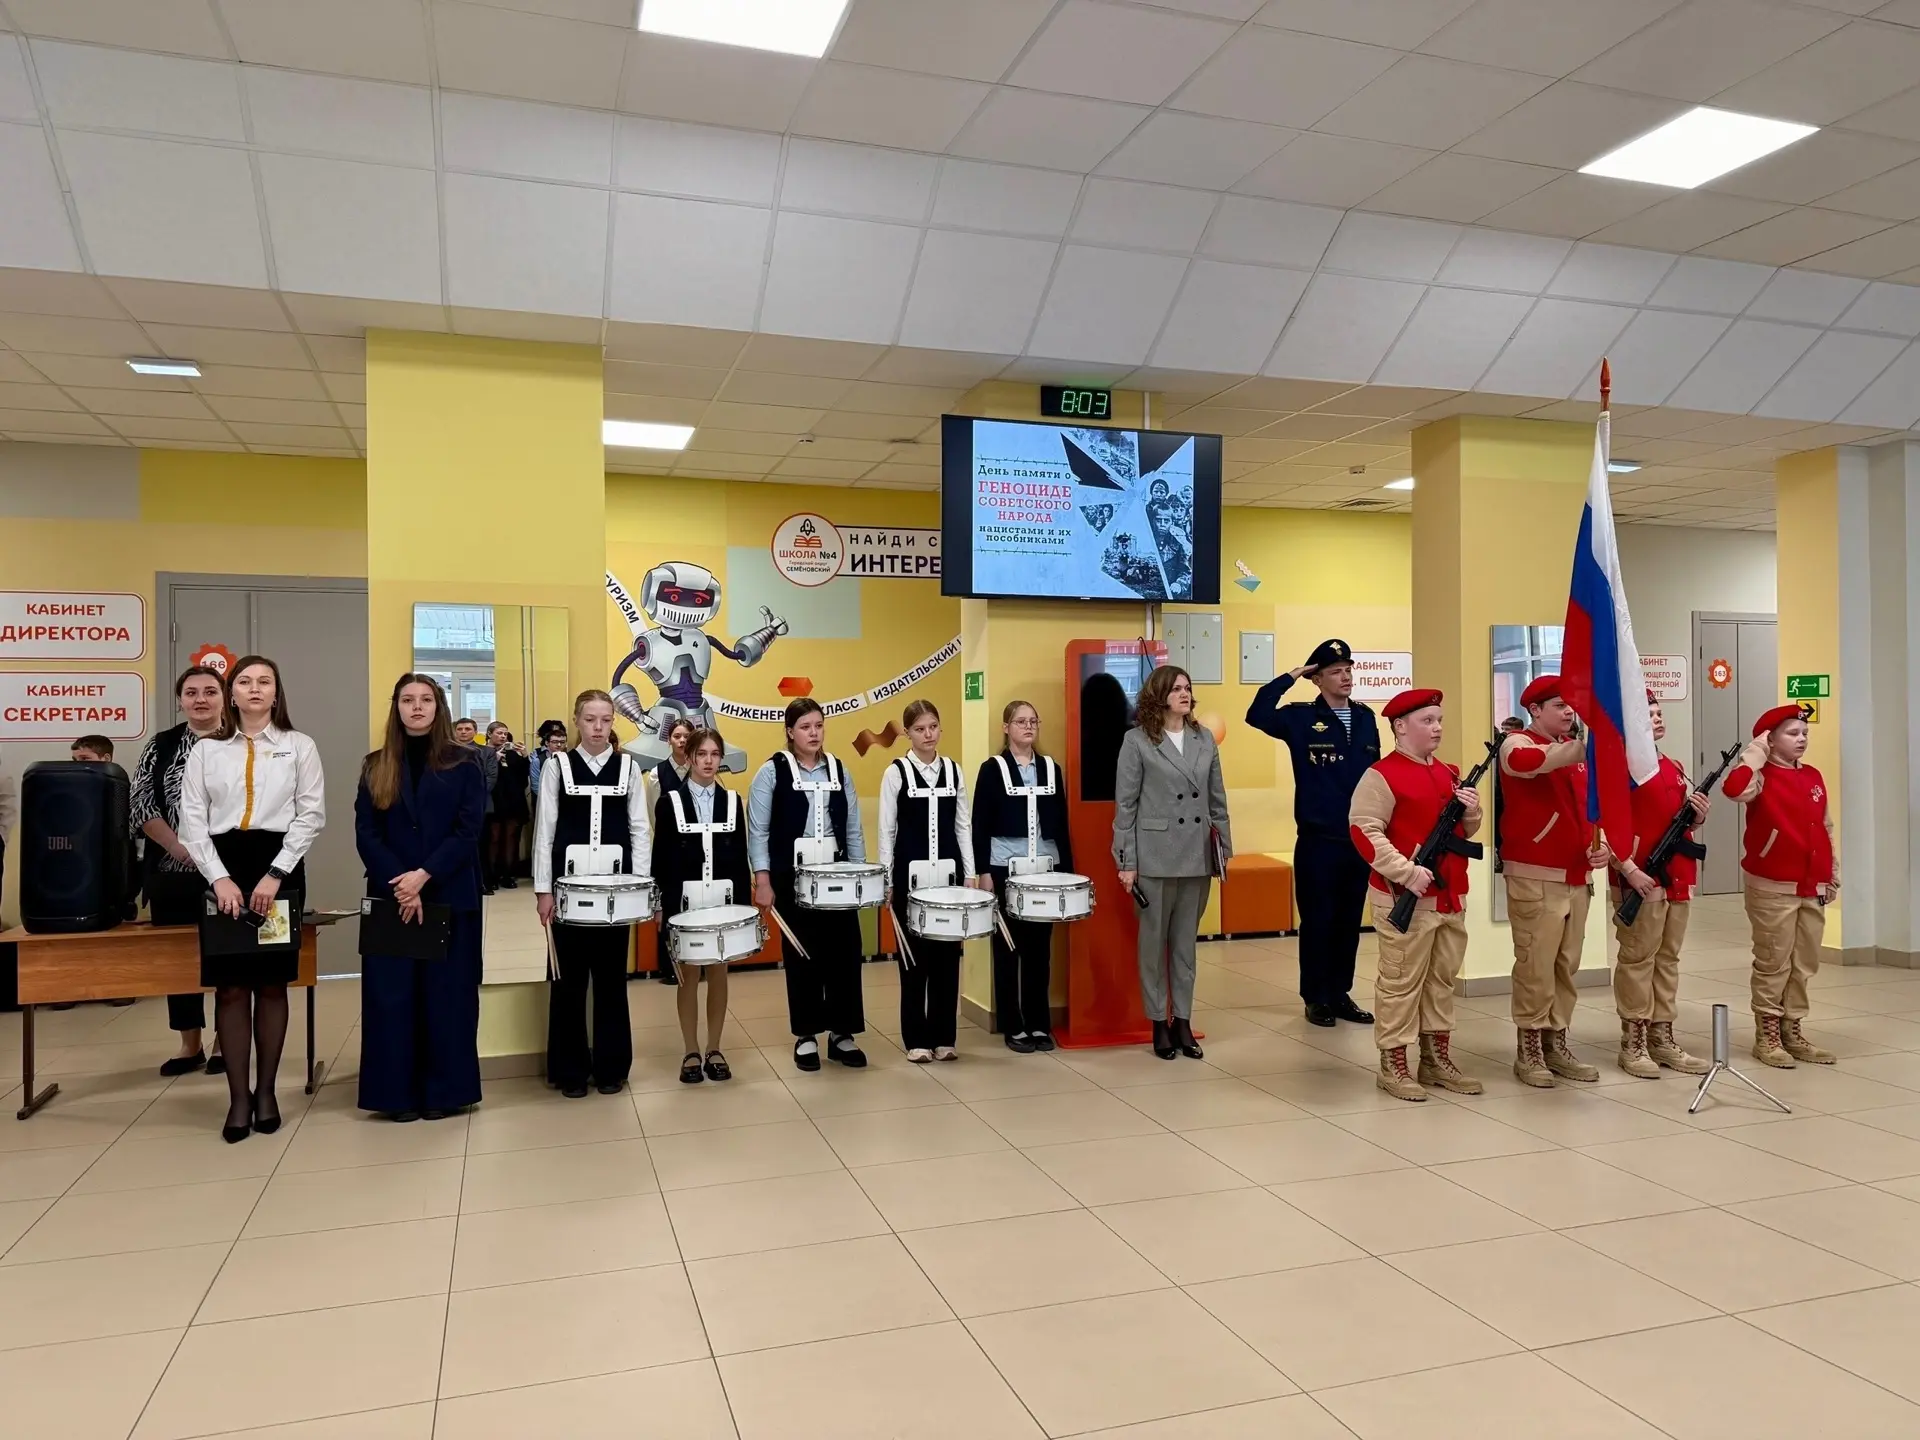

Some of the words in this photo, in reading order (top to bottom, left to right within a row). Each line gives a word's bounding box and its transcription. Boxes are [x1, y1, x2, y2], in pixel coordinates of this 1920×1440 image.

[1061, 390, 1108, 415] 8:03
[978, 465, 1009, 476] День
[1014, 469, 1060, 479] памяти
[1065, 472, 1071, 480] о
[978, 481, 1072, 499] ГЕНОЦИДЕ
[979, 496, 1072, 510] СОВЕТСКОГО
[998, 511, 1053, 523] НАРОДА
[979, 525, 1044, 535] нацистами
[850, 532, 915, 548] НАЙДИ
[986, 534, 1064, 544] пособниками
[779, 550, 817, 559] ШКОЛА
[820, 551, 837, 560] №4
[851, 554, 941, 574] ИНТЕРЕ
[26, 604, 105, 616] КАБИНЕТ
[0, 626, 130, 642] ДИРЕКТОРА
[692, 640, 699, 648] 4
[201, 660, 226, 670] 166
[1639, 658, 1668, 666] АБИНЕТ
[873, 642, 958, 700] ИЗДАТЕЛЬСКИЙ
[1359, 677, 1412, 687] ПЕДАГОГА
[1645, 680, 1680, 688] СТВЕННОЙ
[27, 685, 106, 697] КАБИНЕТ
[4, 707, 127, 721] СЕКРЕТАРЯ
[720, 702, 785, 721] ИНЖЕНЕР
[48, 836, 72, 850] JBL
